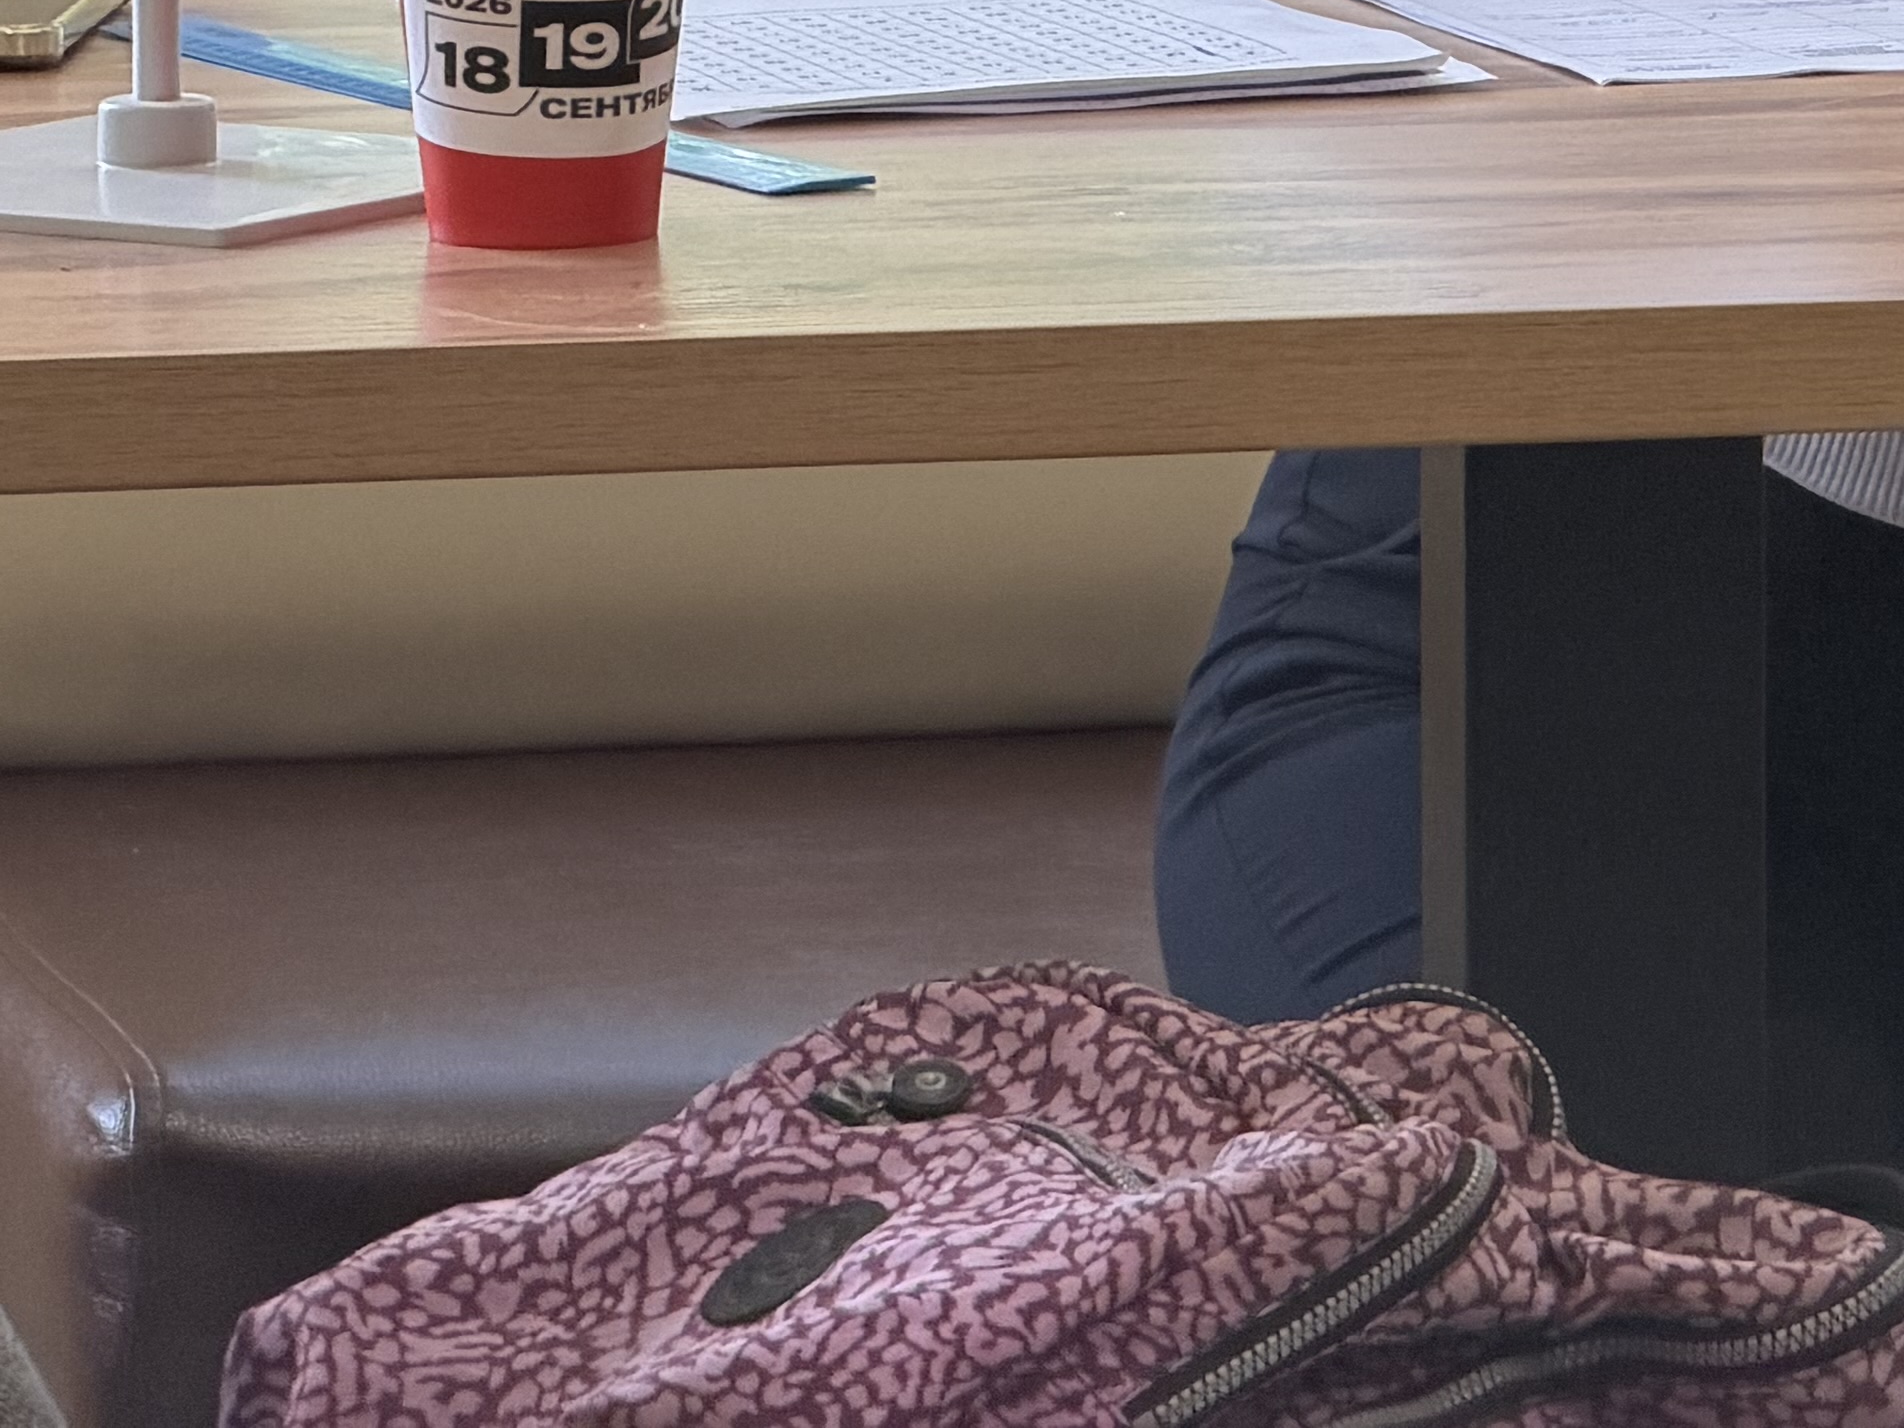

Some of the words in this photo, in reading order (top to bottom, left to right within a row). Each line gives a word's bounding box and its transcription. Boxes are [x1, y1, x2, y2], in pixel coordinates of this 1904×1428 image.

[434, 41, 511, 94] 18
[533, 21, 621, 70] 19
[539, 78, 675, 119] СЕНТЯБ
